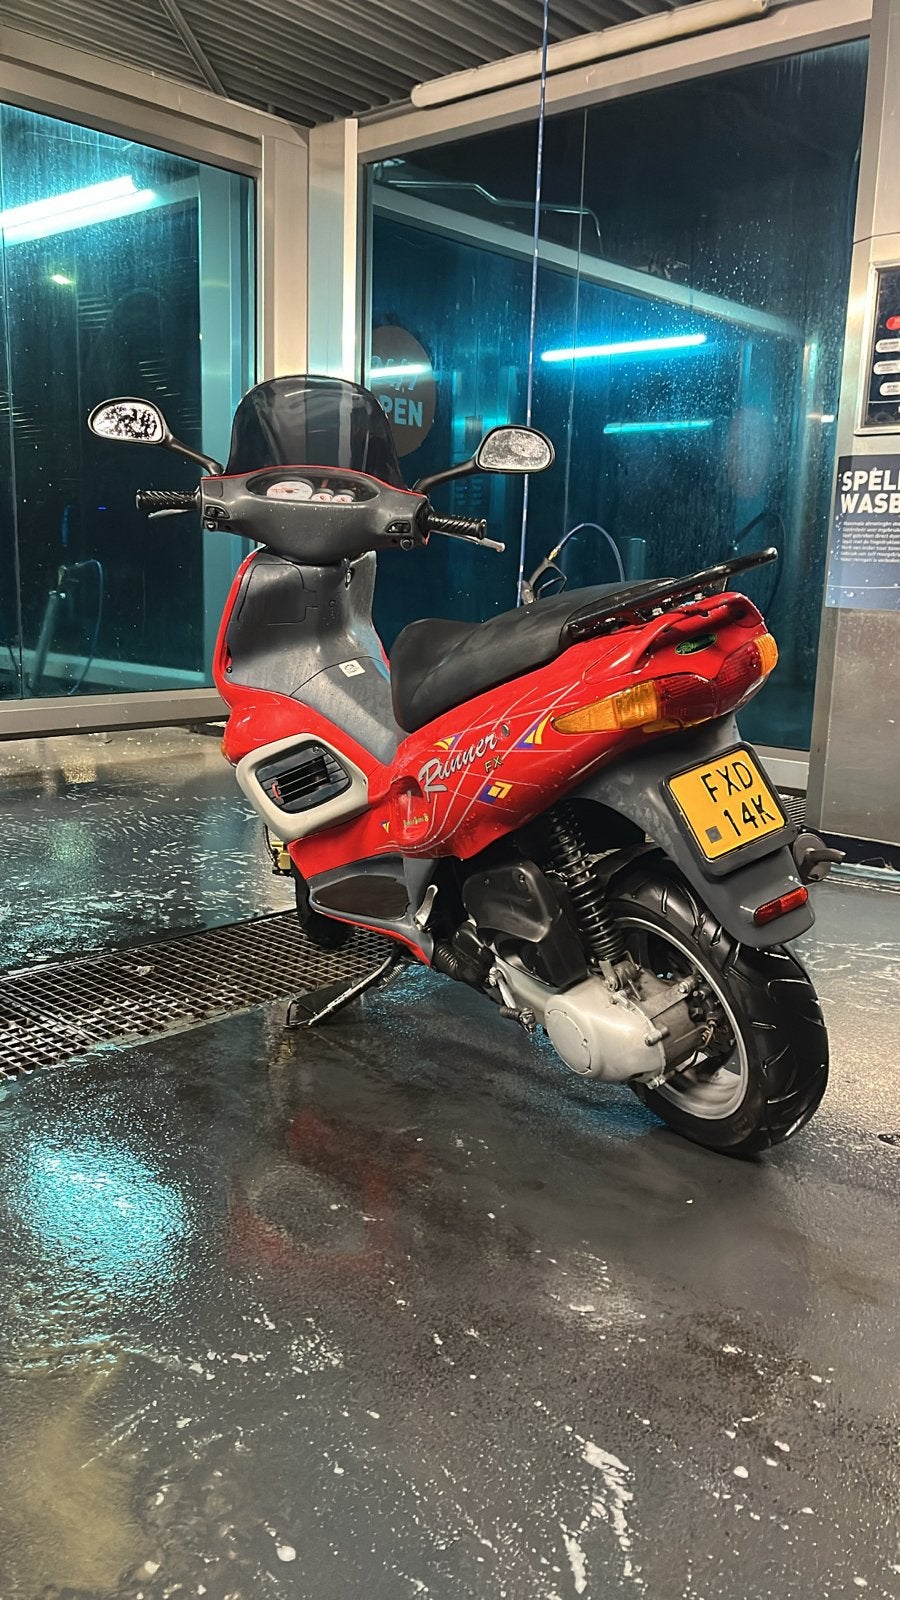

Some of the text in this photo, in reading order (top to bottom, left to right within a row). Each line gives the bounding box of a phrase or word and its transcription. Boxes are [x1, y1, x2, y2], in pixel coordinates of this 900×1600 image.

[379, 394, 424, 427] PEN
[841, 469, 900, 491] SPEL
[418, 732, 498, 803] Runner
[484, 755, 502, 773] FX
[700, 761, 754, 803] FXD
[723, 794, 776, 837] 14K
